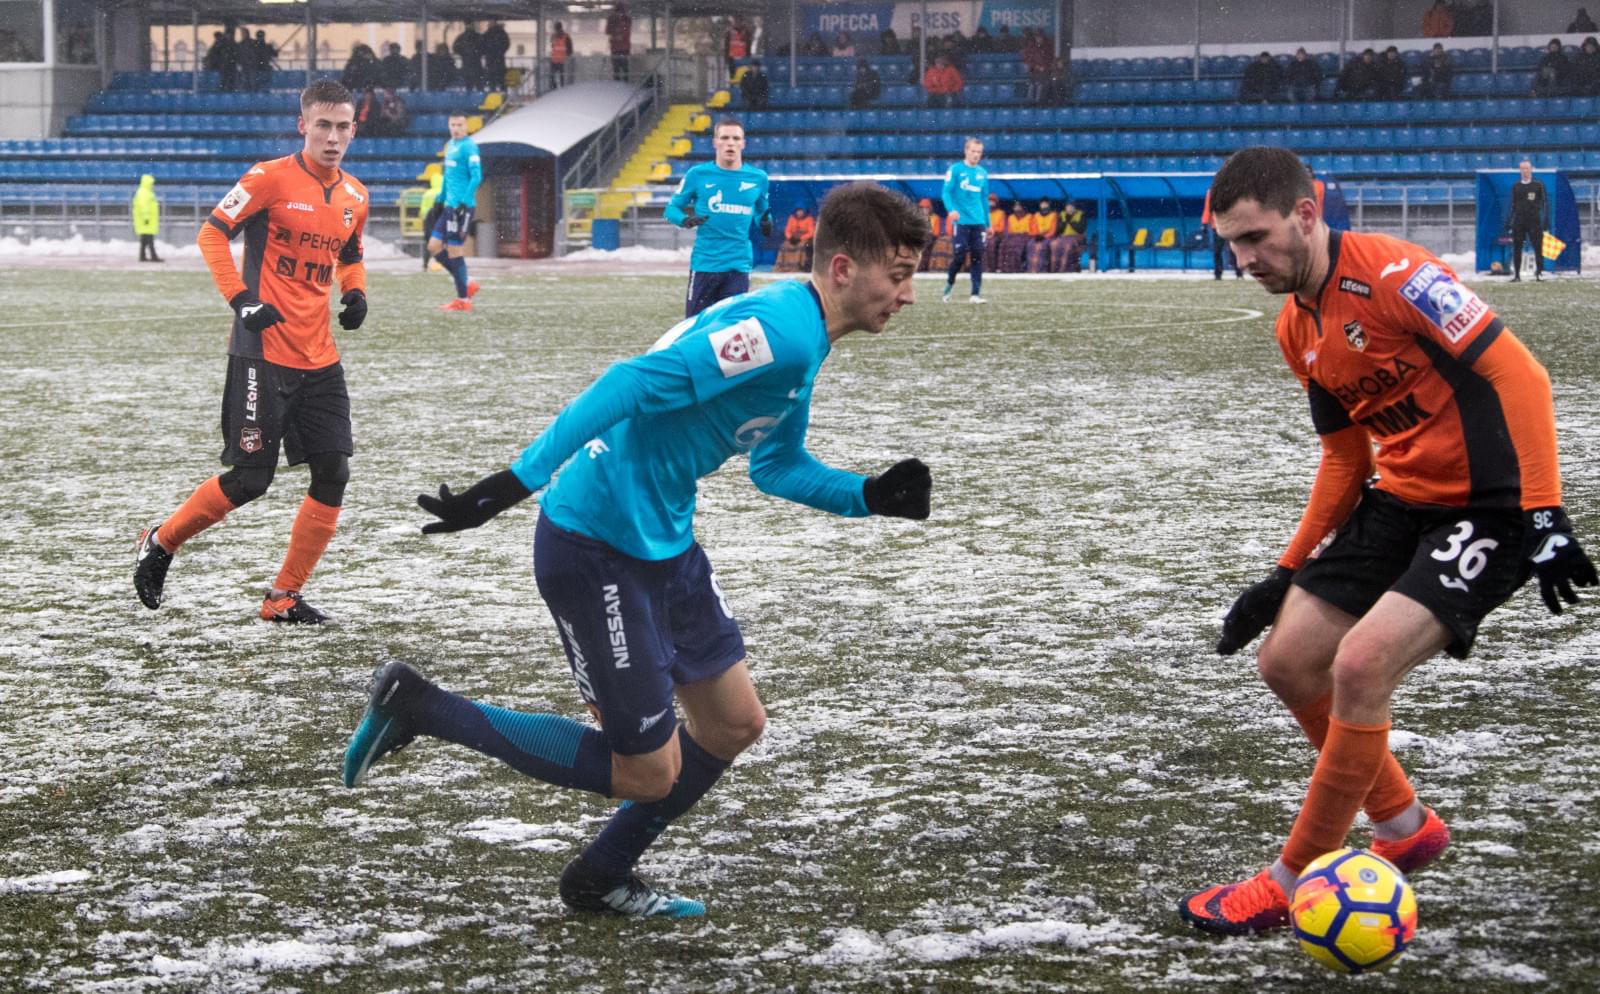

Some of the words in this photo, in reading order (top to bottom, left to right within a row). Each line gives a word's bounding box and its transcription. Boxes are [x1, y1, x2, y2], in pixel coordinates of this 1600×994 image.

[819, 14, 878, 32] ПРЕССА
[991, 8, 1051, 27] PRESSE
[300, 231, 343, 254] РЕНО
[304, 261, 333, 285] ТМ
[1334, 358, 1417, 405] ЕНОВА
[1430, 520, 1499, 580] 36
[603, 584, 631, 669] NISSAN
